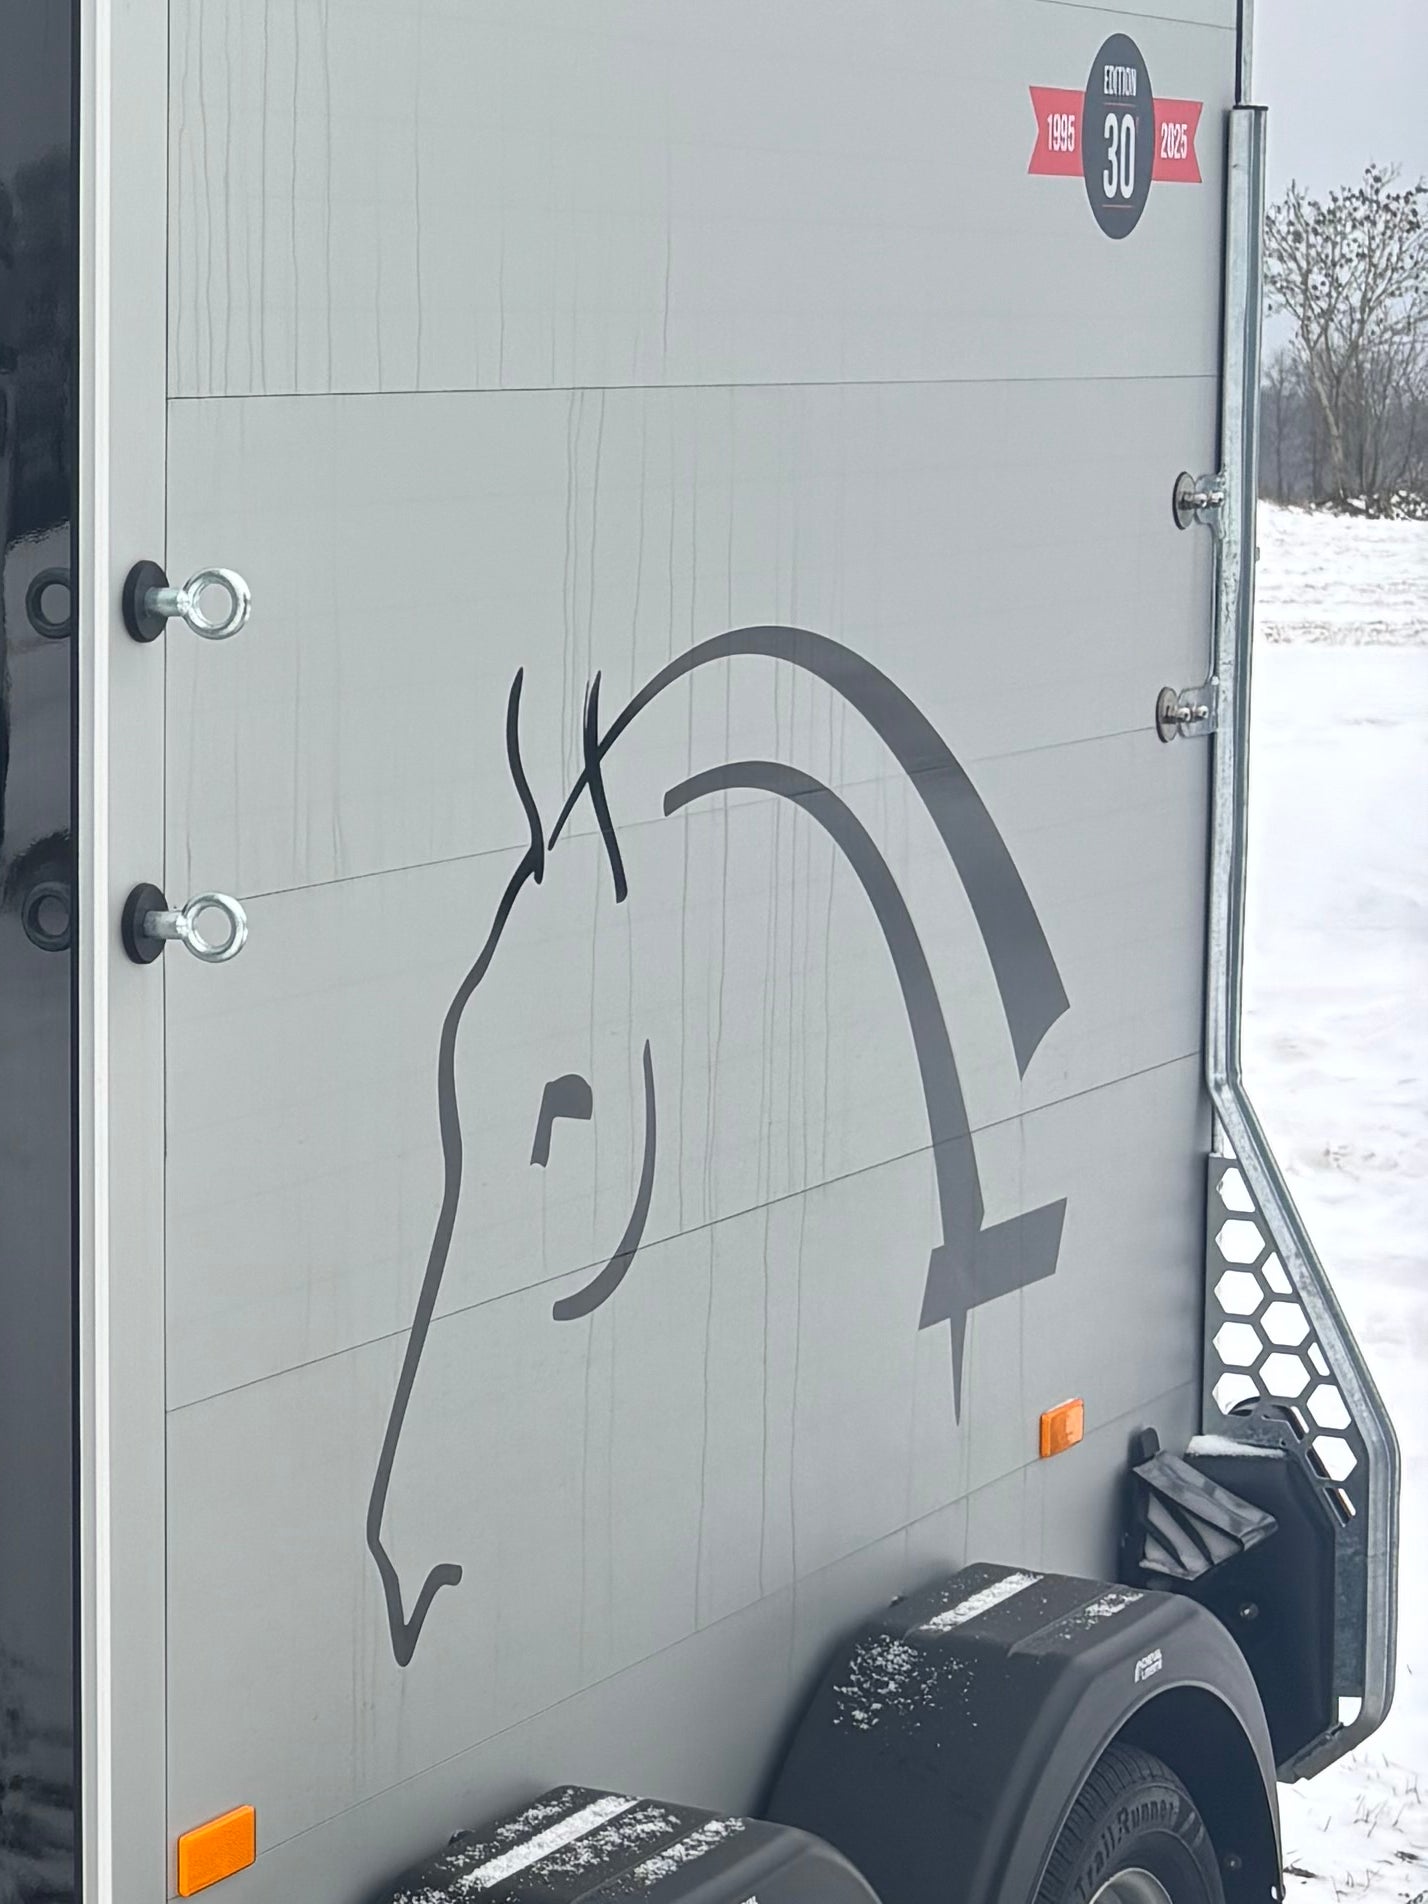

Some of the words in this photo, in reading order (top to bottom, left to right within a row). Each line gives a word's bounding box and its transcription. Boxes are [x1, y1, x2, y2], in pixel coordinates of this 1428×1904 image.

[1103, 65, 1137, 96] EDITION
[1047, 114, 1076, 152] 1995
[1160, 123, 1188, 159] 2025
[1103, 113, 1136, 199] 30
